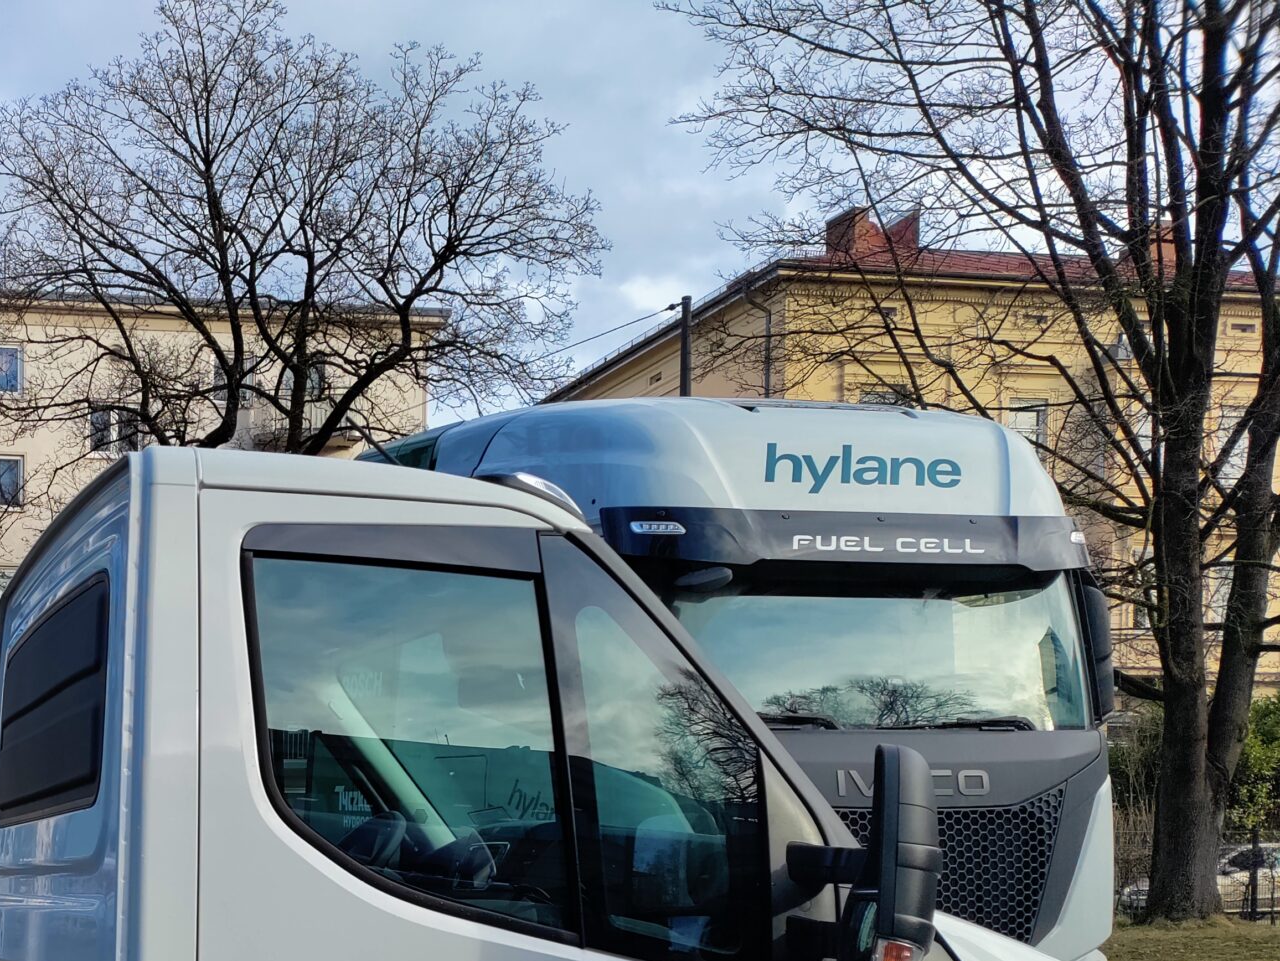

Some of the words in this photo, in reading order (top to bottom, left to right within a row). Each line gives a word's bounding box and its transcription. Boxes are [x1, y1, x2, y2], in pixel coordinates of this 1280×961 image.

[764, 442, 963, 495] hylane
[792, 534, 885, 552] FUEL
[895, 537, 985, 554] CELL
[836, 769, 991, 797] IVCO
